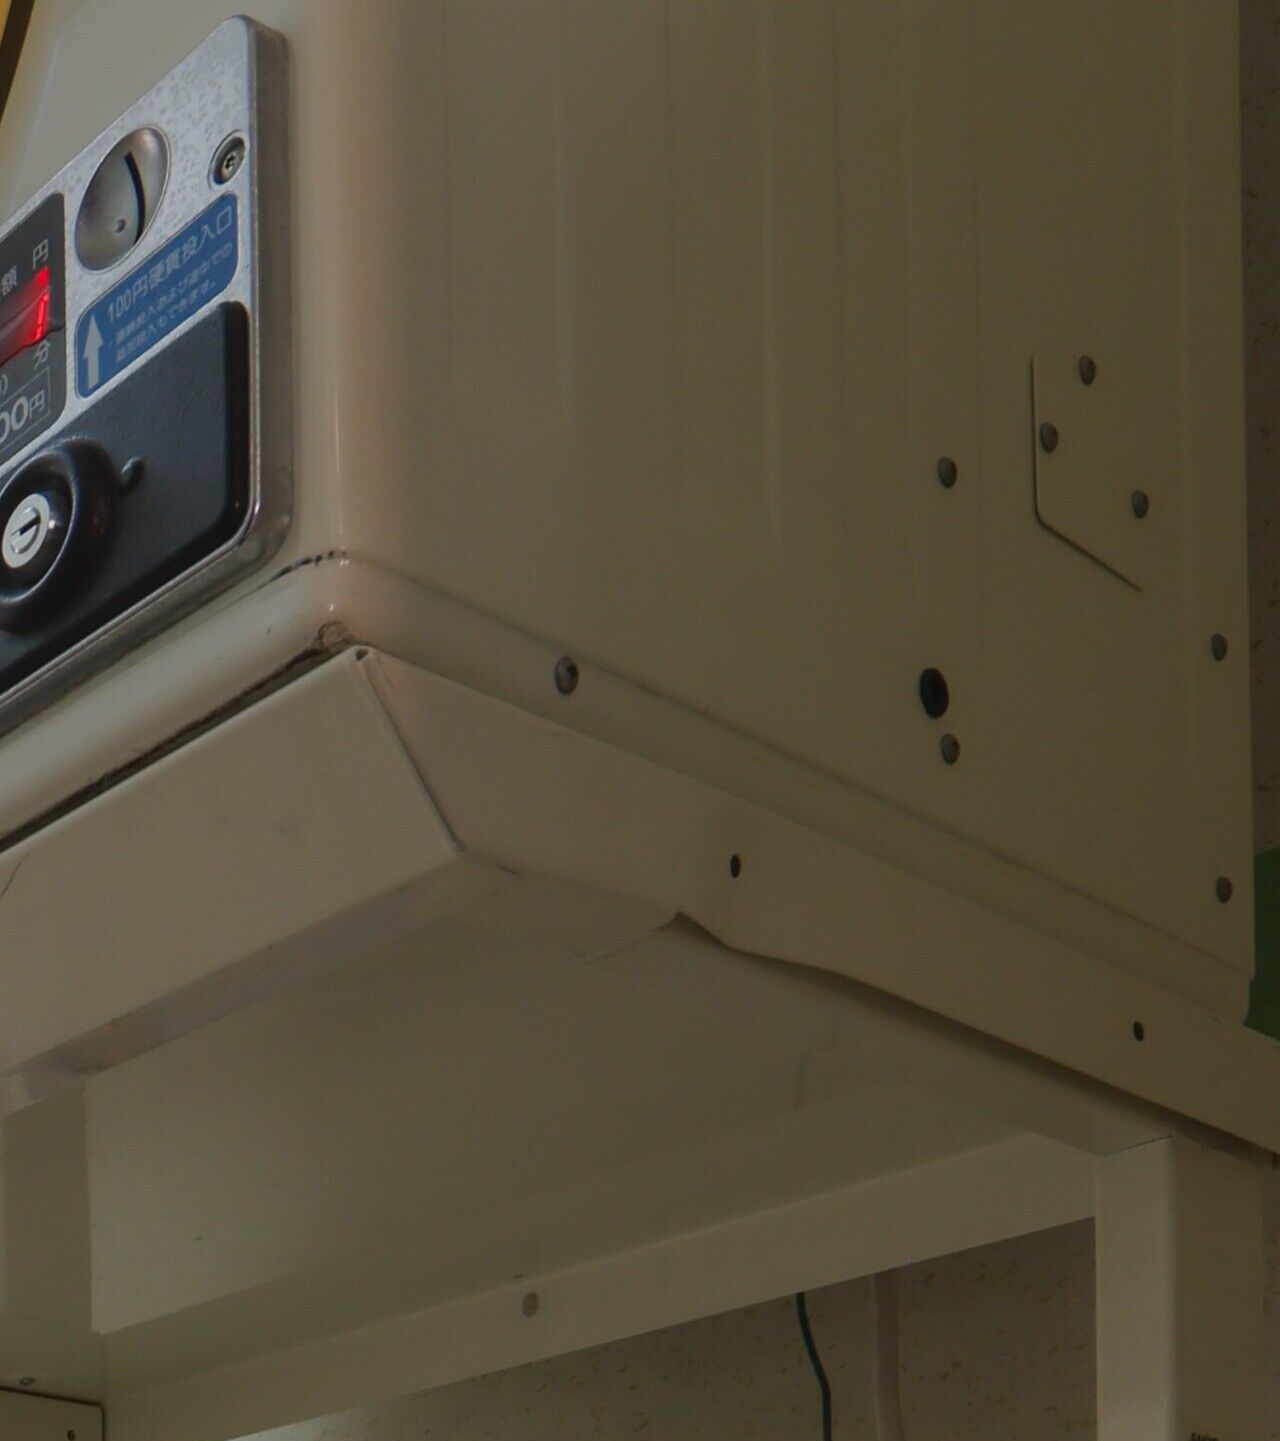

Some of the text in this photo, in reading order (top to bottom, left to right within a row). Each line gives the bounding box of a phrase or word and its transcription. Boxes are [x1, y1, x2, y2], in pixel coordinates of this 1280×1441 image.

[32, 239, 49, 268] 円
[107, 206, 232, 322] 100円硬貨投入口
